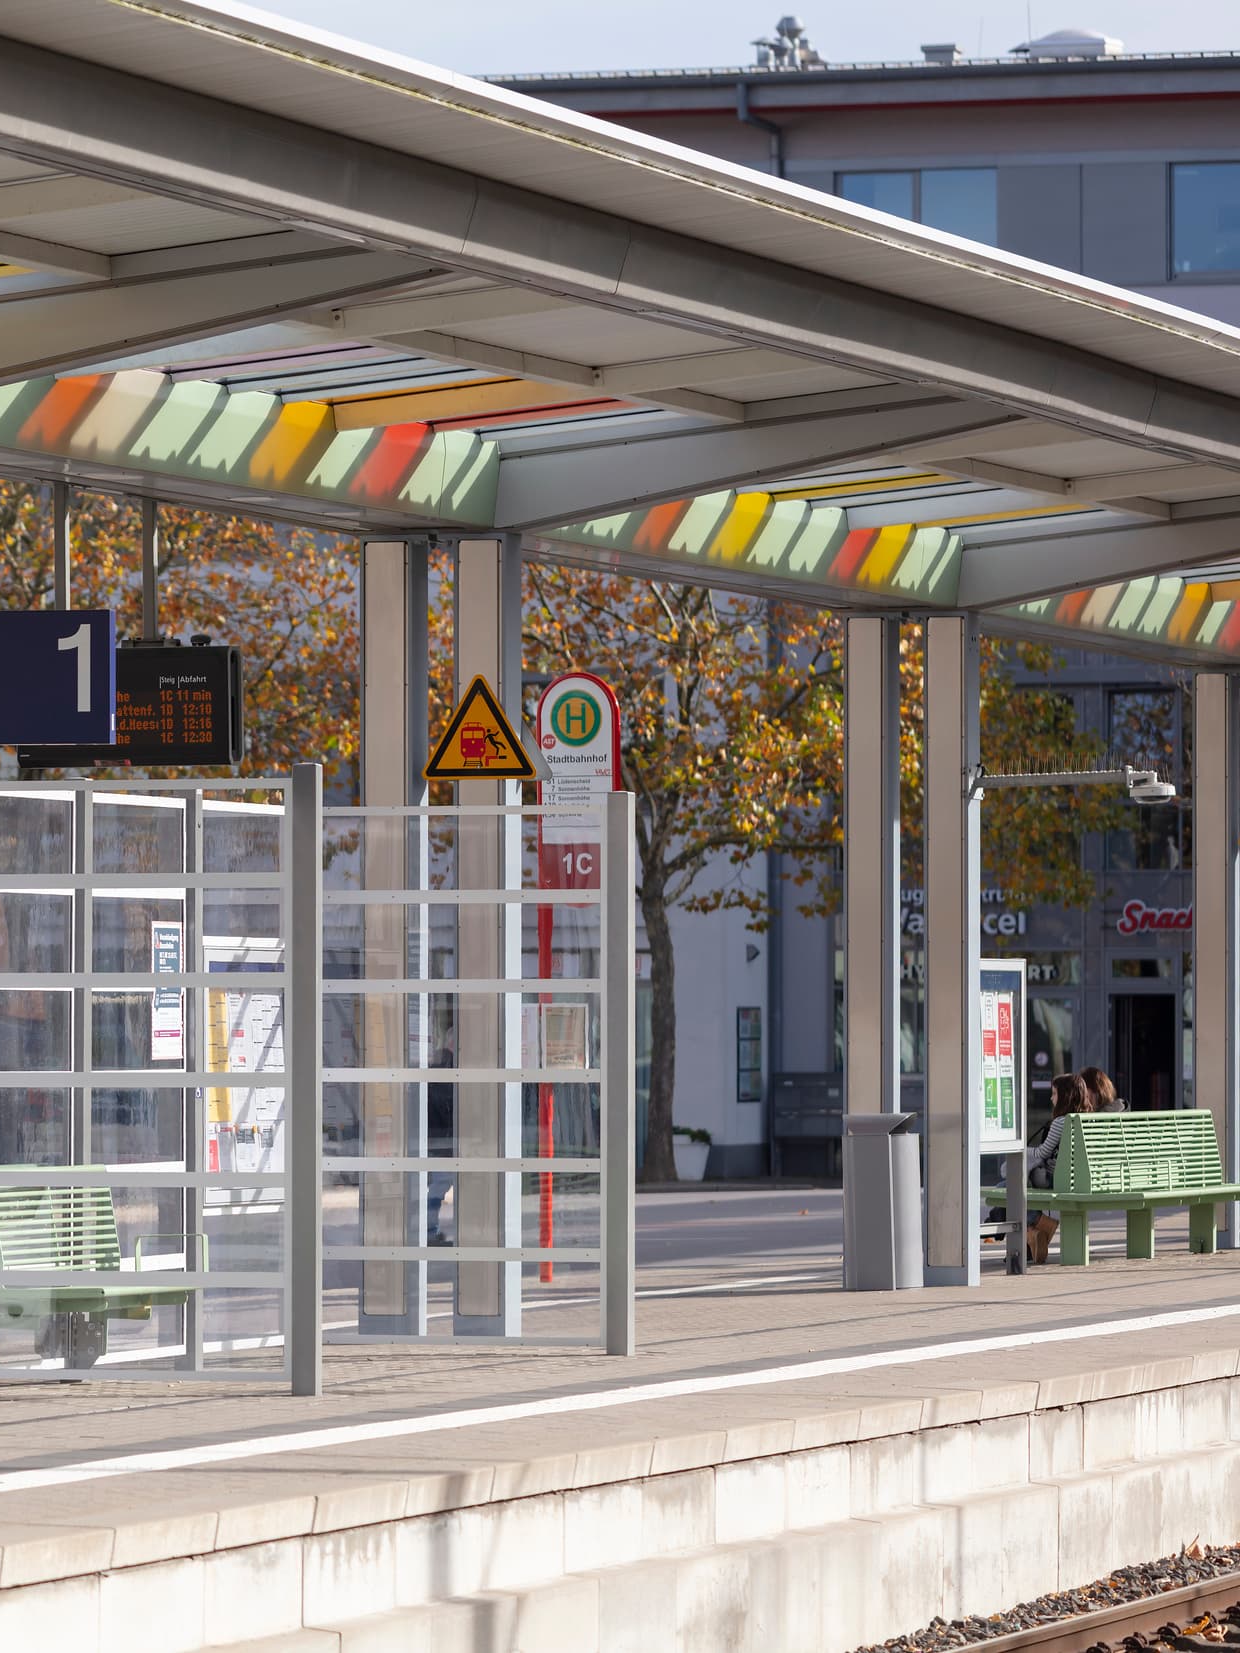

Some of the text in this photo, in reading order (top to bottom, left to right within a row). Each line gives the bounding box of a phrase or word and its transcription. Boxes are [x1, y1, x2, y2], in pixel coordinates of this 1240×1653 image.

[58, 623, 91, 713] 1
[161, 675, 207, 685] Steig Abfahrt
[160, 690, 174, 702] 1C
[192, 690, 212, 701] min
[182, 703, 212, 716] 12:10
[160, 732, 174, 744] 1C
[182, 731, 213, 744] 12:30
[547, 754, 608, 764] Stadtbahnhof
[562, 852, 593, 875] 1C
